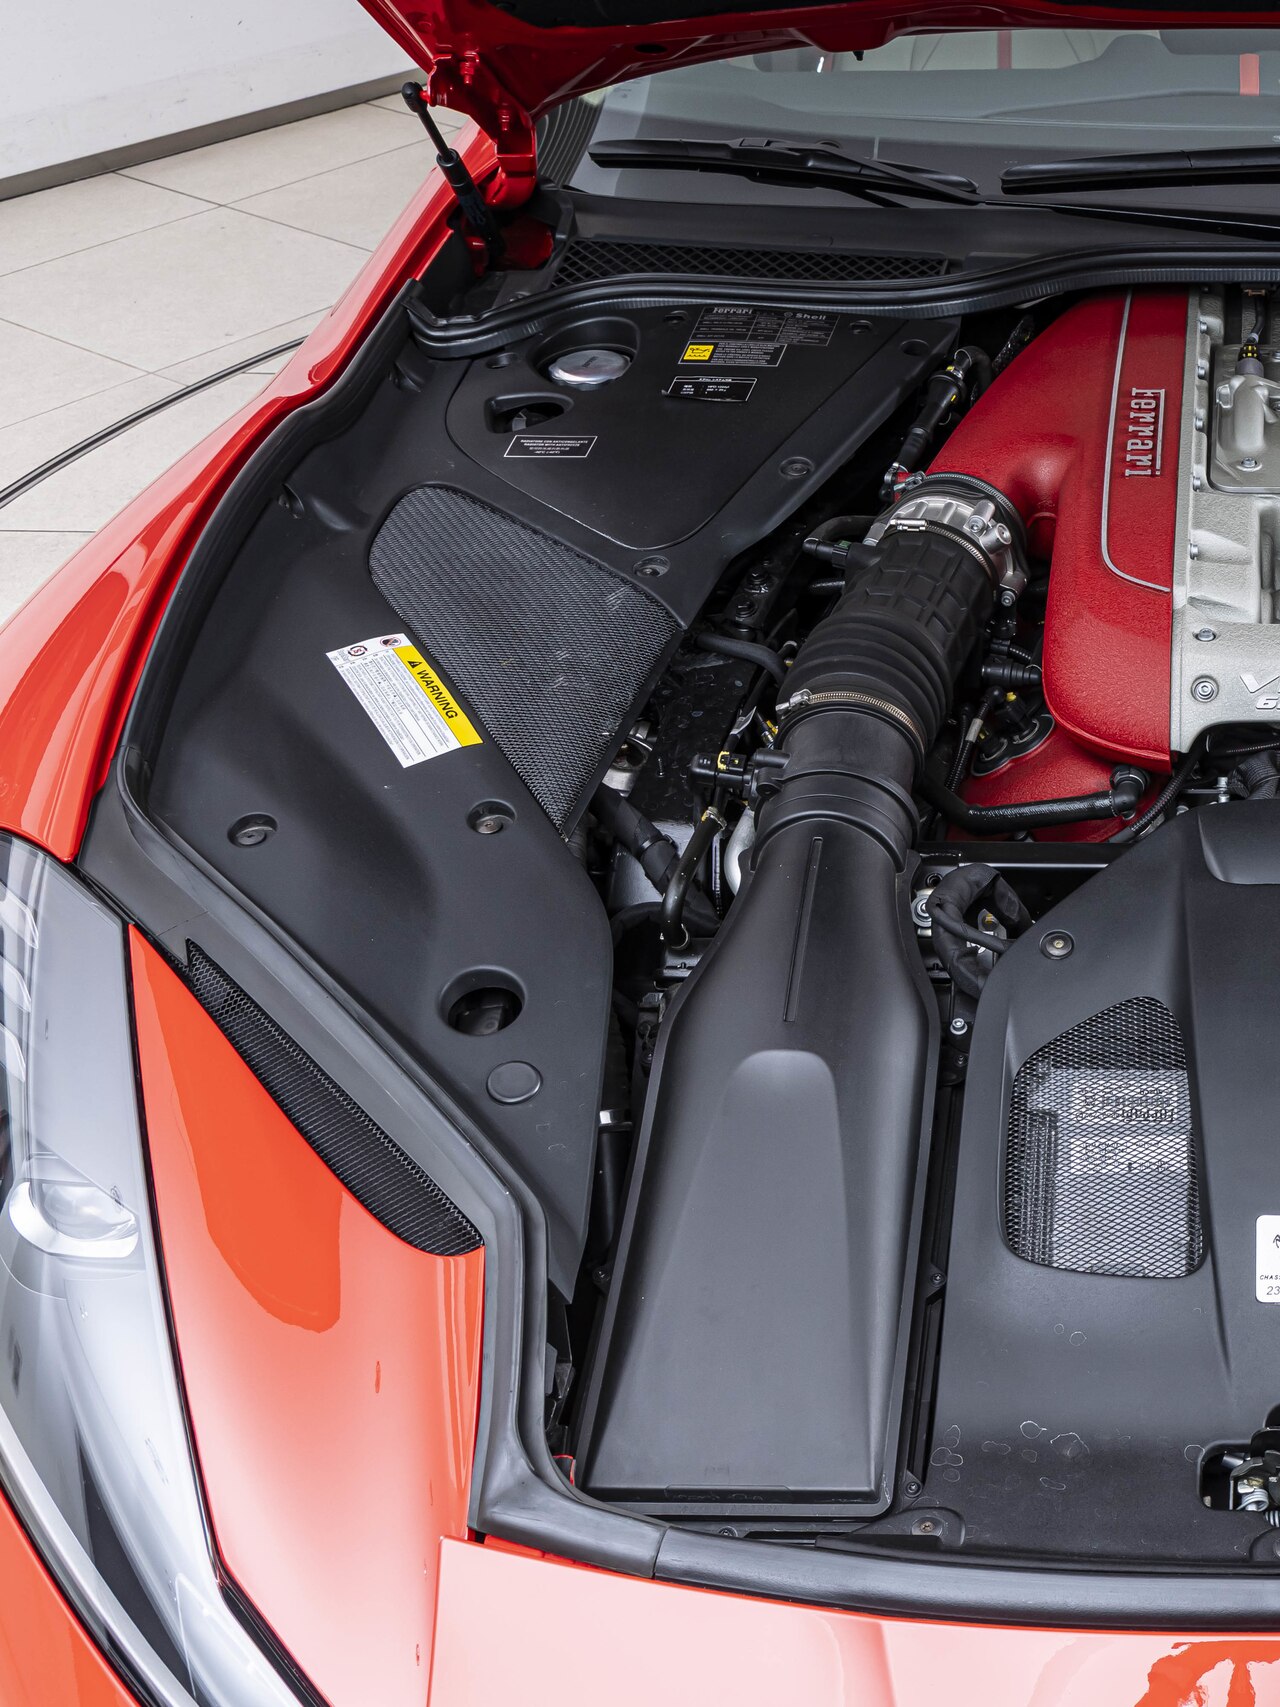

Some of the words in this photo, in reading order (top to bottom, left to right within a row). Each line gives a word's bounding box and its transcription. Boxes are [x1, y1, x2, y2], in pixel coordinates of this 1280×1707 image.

[712, 307, 753, 315] Ferrari
[1125, 387, 1165, 477] Ferrari
[417, 669, 458, 720] WARNING
